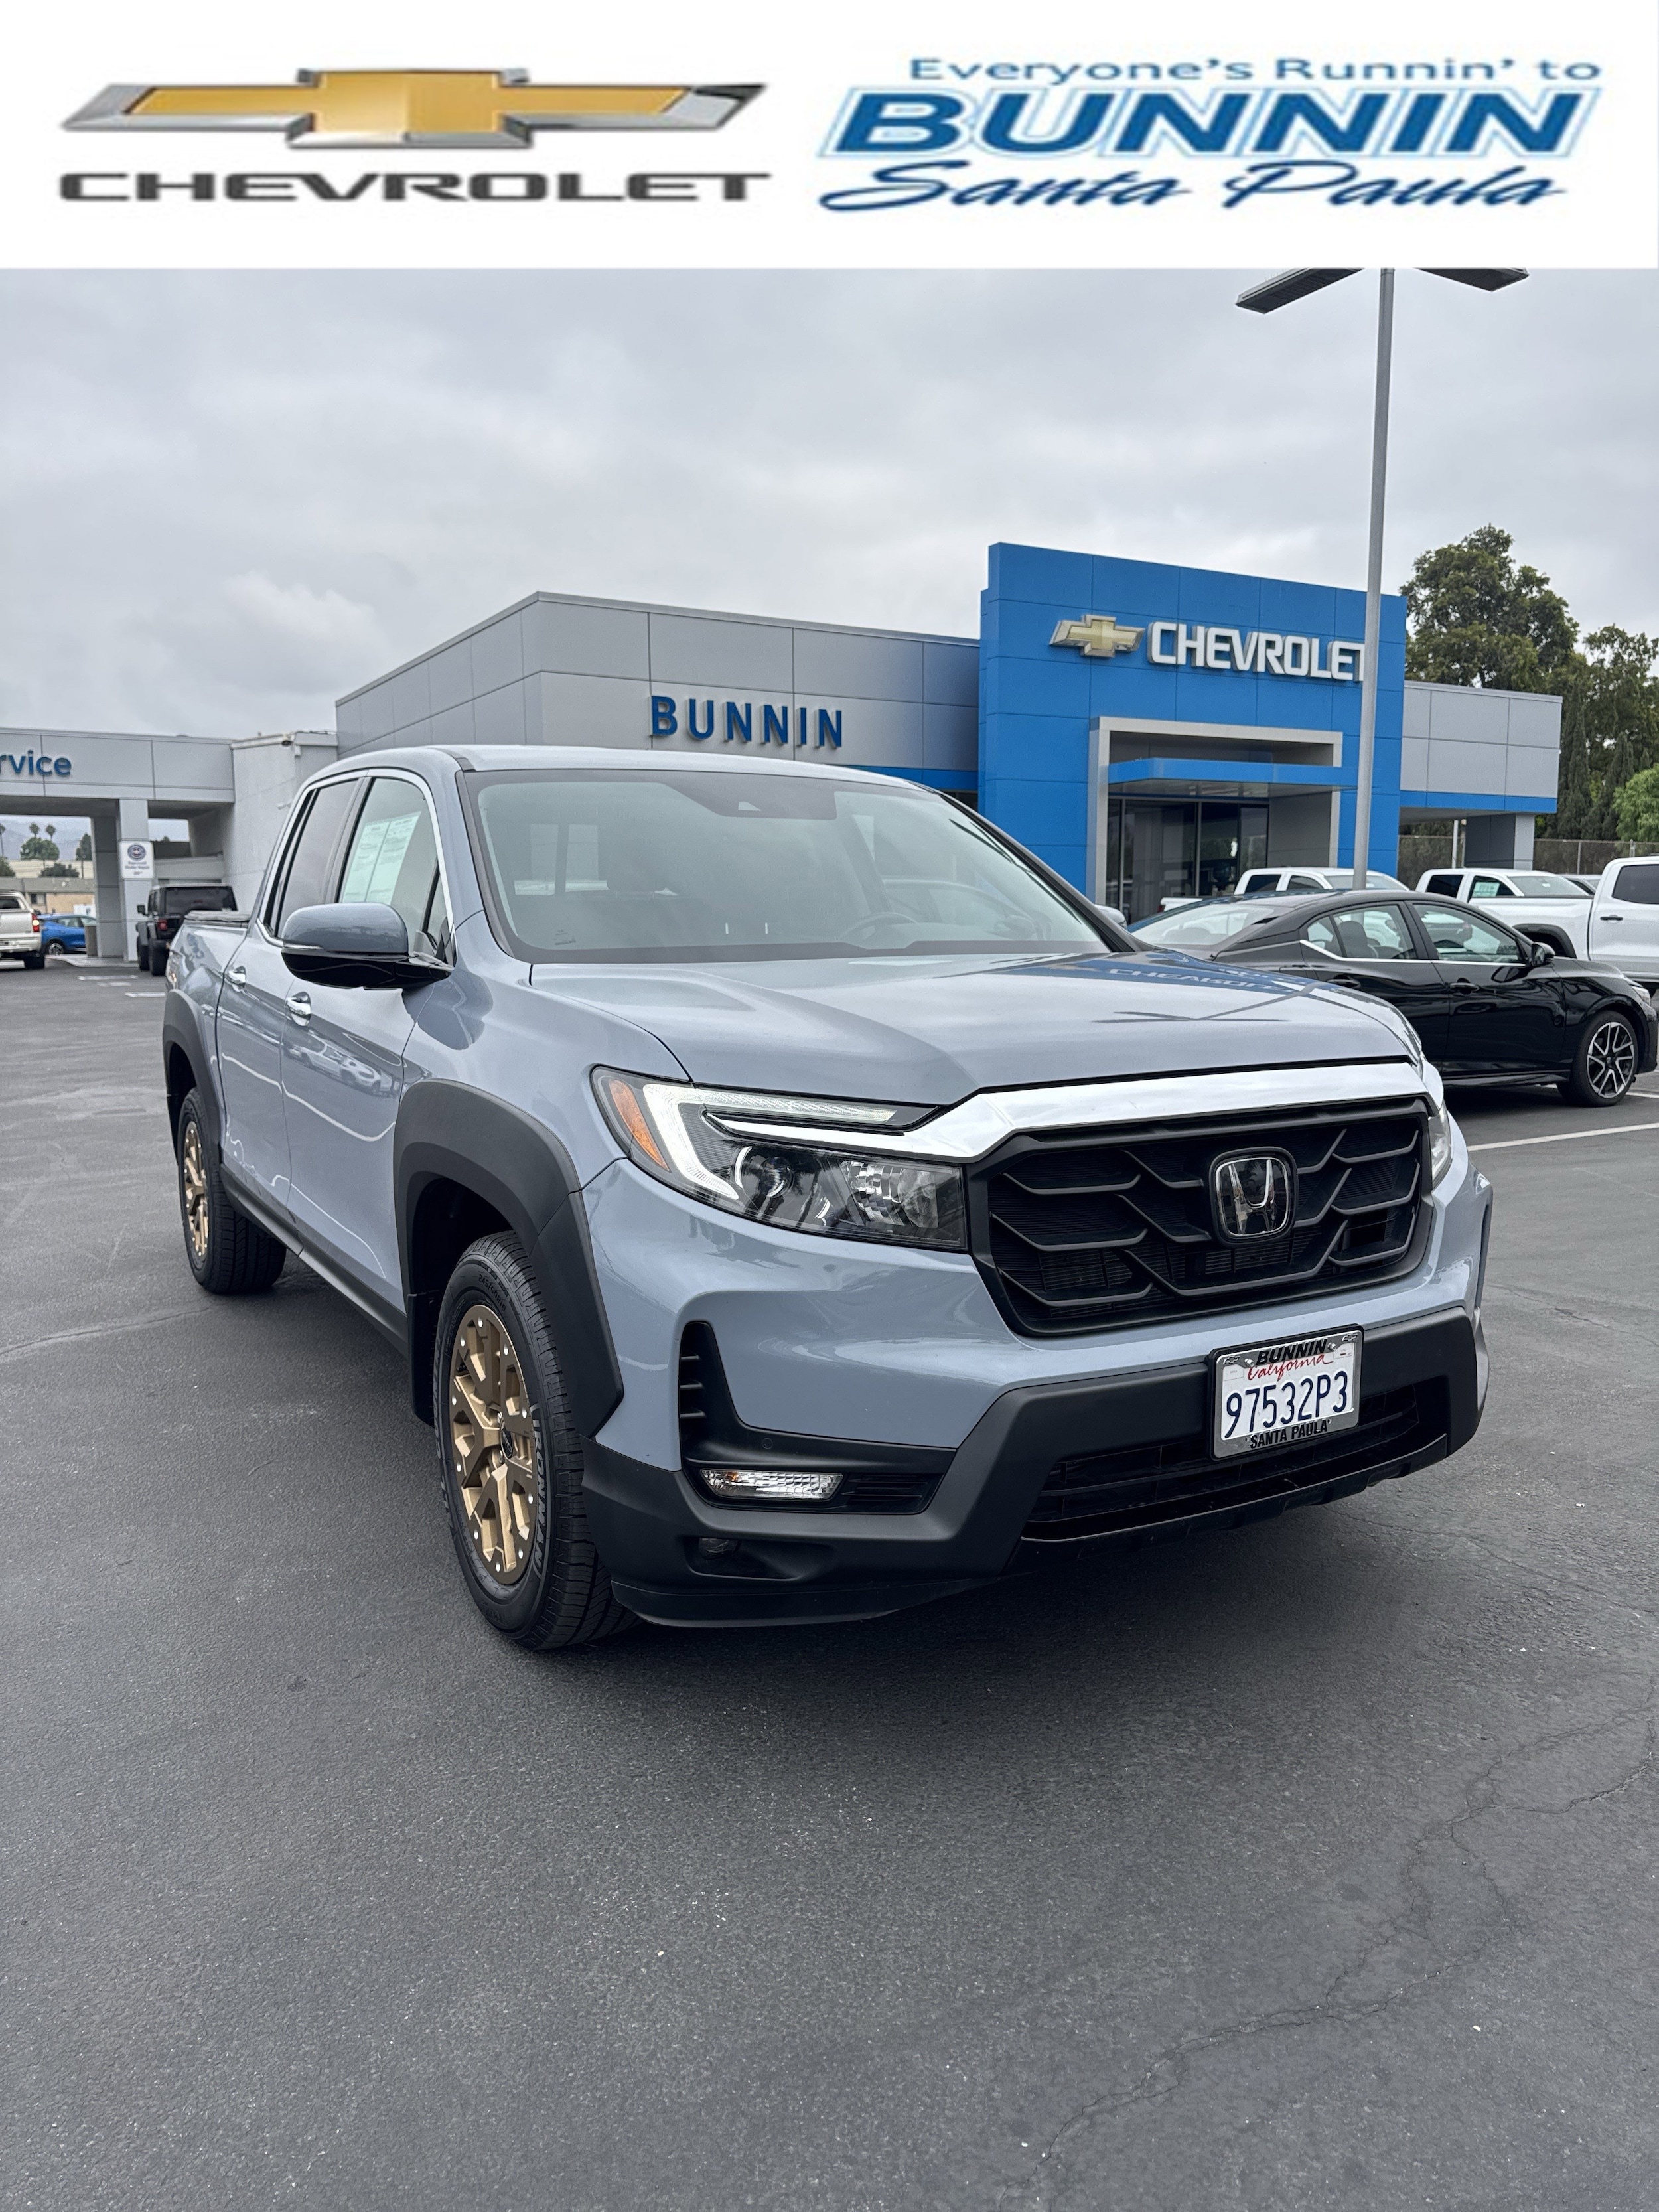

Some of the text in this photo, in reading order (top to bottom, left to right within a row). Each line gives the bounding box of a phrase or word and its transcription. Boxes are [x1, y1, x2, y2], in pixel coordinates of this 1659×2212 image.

[649, 695, 842, 748] BUNNIN
[1247, 1353, 1334, 1381] California
[1256, 1339, 1328, 1366] BUNNIN
[1224, 1370, 1348, 1439] 97532P3
[1250, 1418, 1328, 1449] SANTA PAULA
[532, 1419, 545, 1570] IRONMAN
